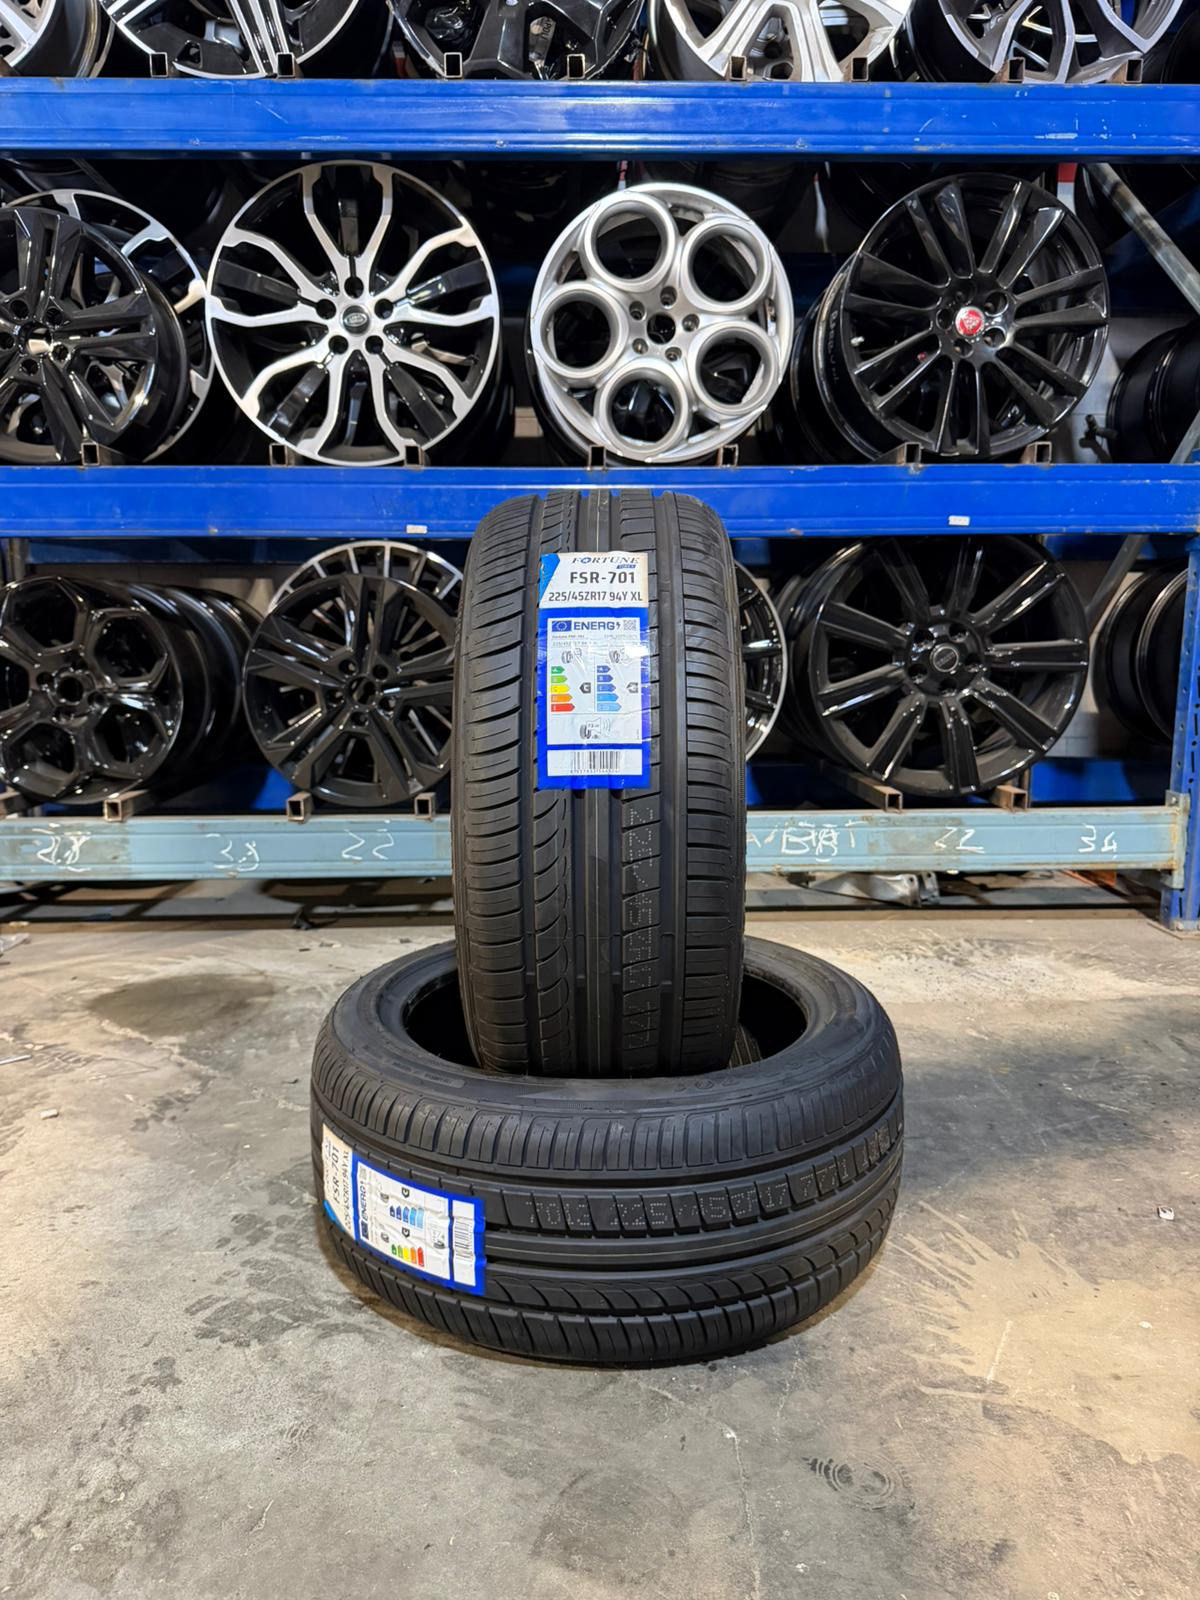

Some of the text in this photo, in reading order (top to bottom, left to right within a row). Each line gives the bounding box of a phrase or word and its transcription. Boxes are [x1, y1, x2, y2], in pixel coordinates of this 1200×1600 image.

[572, 556, 640, 564] FORTUNE
[570, 571, 635, 584] FSR-701
[548, 590, 643, 602] 225/45ZR17 94Y XL
[332, 1145, 340, 1204] FSR-701
